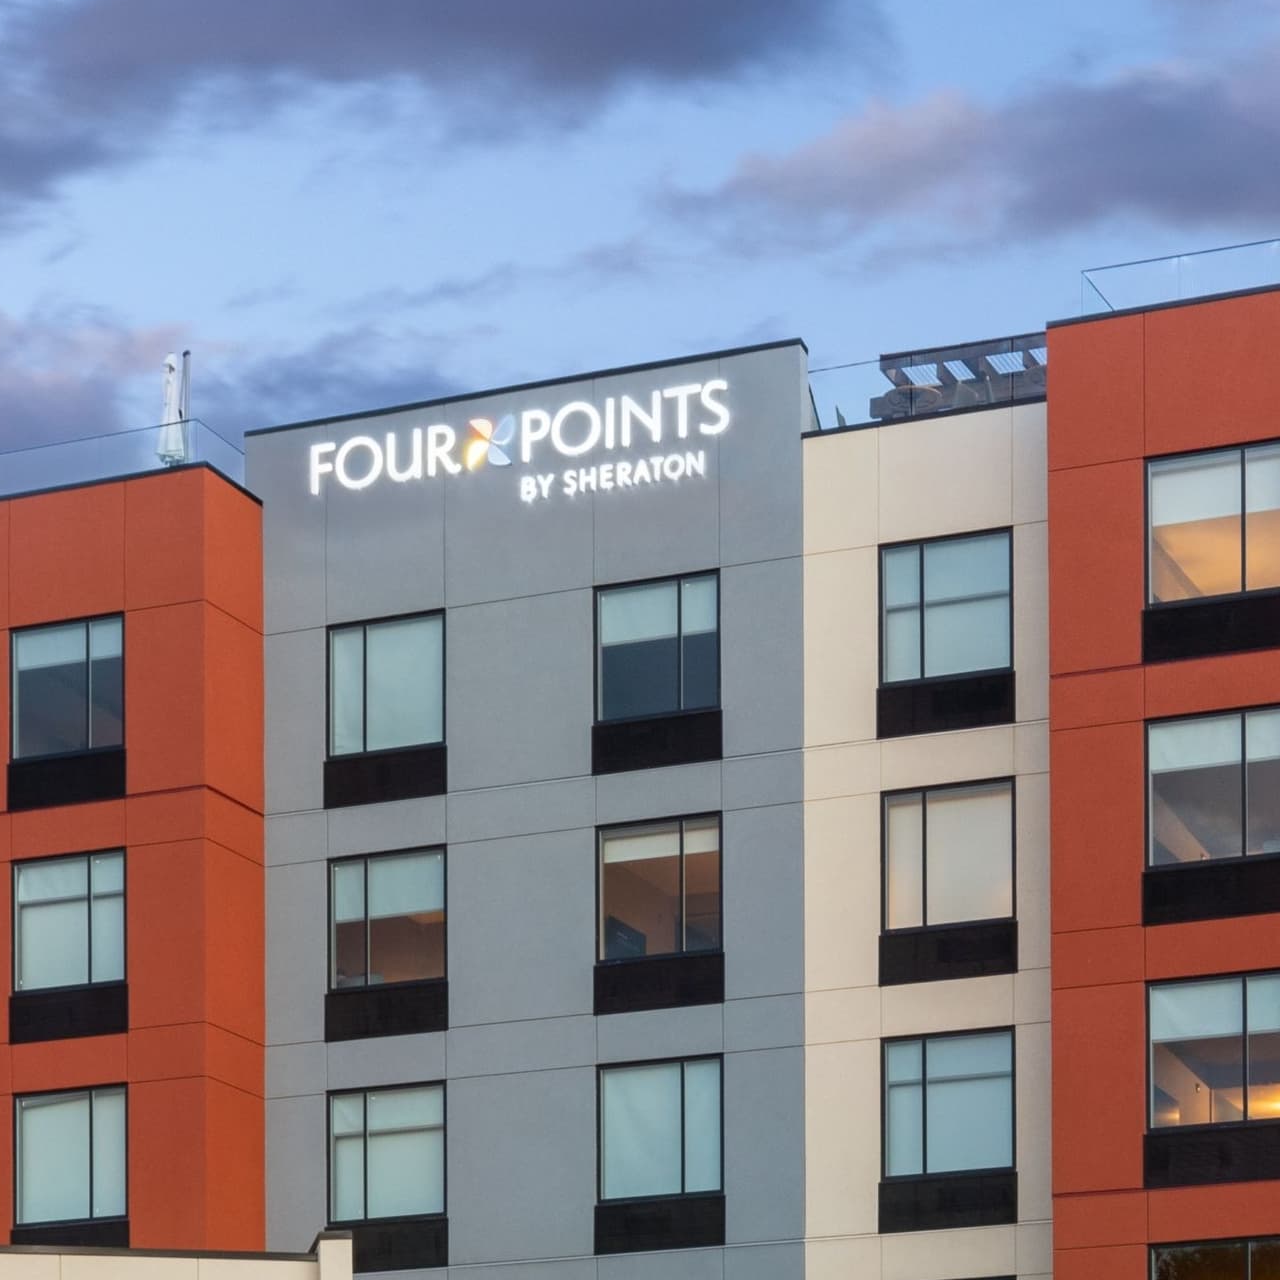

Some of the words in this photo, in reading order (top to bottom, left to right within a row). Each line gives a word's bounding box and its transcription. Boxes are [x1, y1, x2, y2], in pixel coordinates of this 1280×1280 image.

[310, 425, 462, 495] FOUR
[521, 379, 731, 463] POINTS
[520, 473, 555, 503] BY
[562, 450, 705, 498] SHERATON
